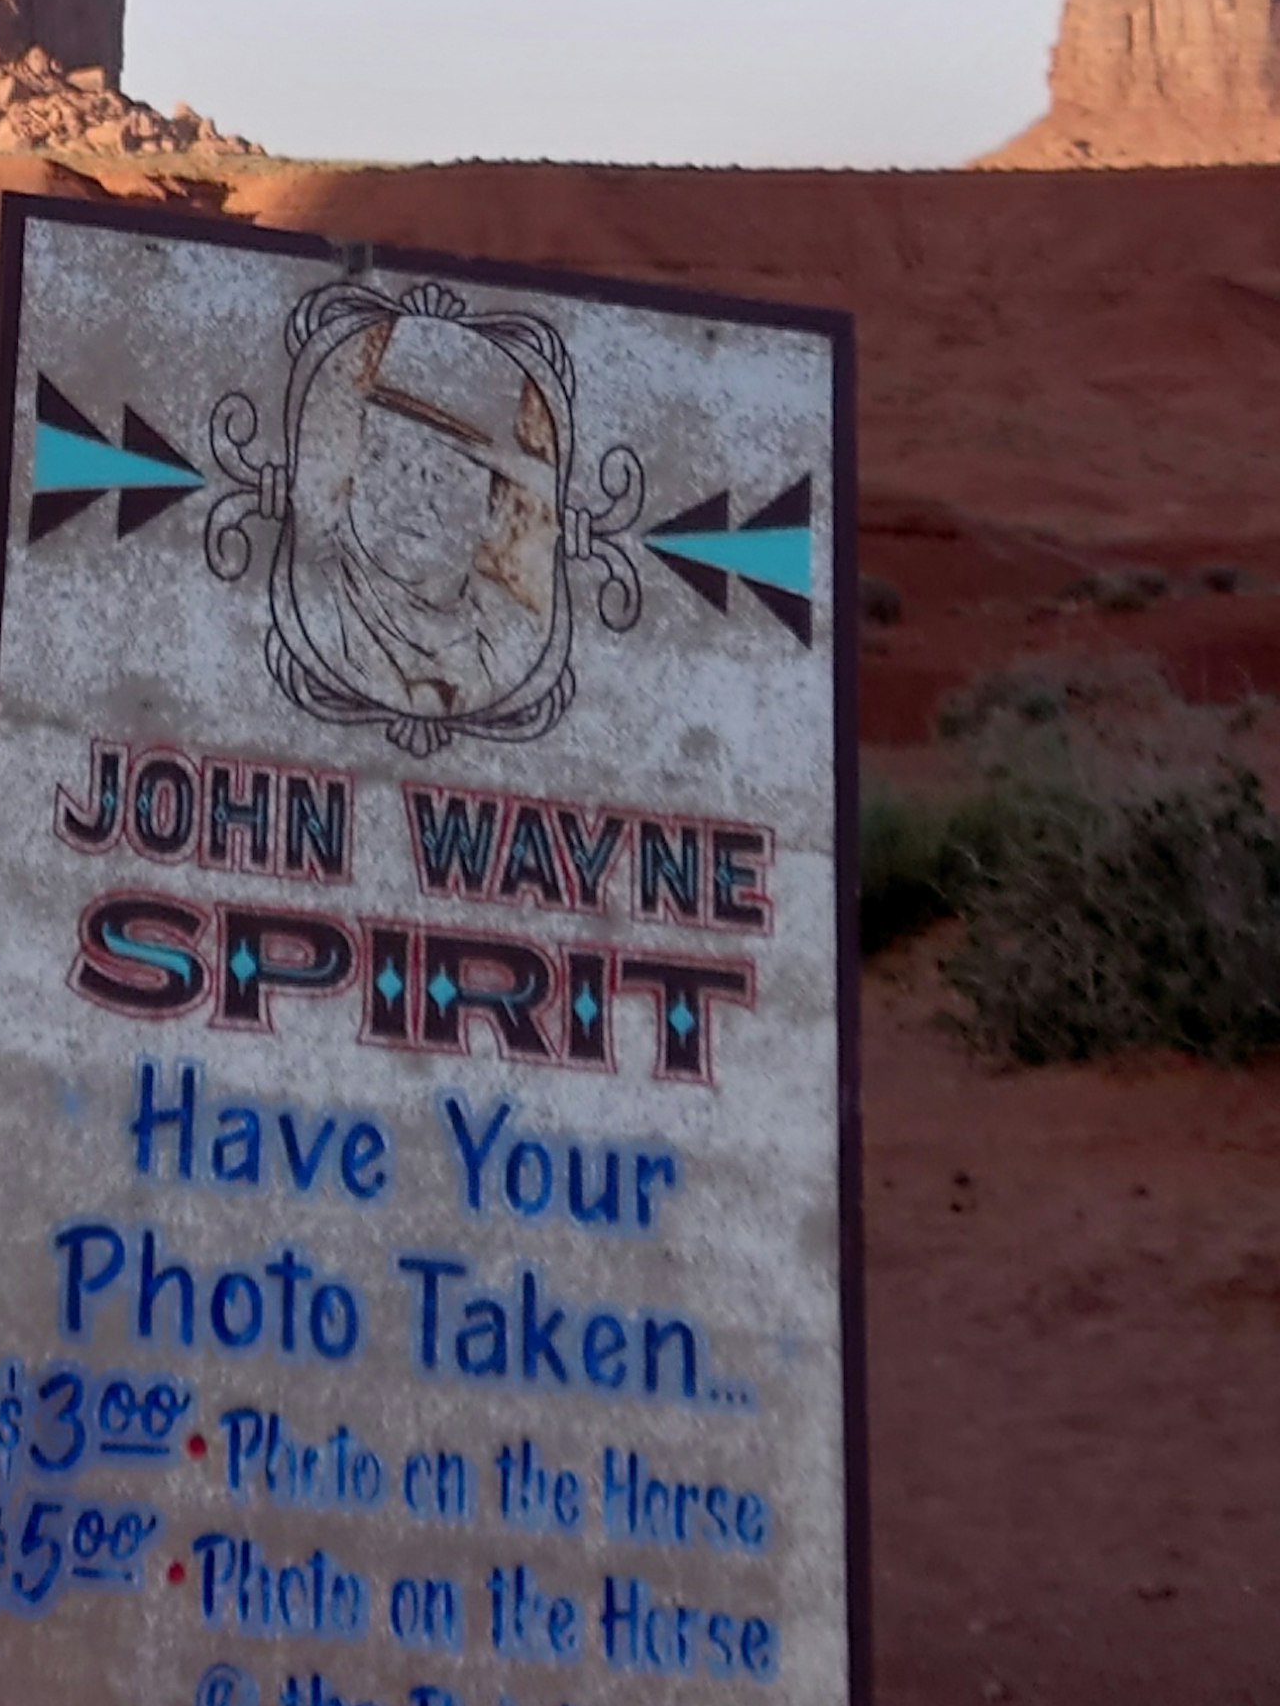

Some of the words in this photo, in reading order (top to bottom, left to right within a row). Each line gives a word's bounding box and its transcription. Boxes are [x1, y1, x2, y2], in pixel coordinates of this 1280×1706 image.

[54, 738, 355, 886] JOHN
[401, 780, 774, 935] WAYNE
[65, 888, 757, 1086] SPIRIT
[130, 1058, 390, 1203] Have
[444, 1094, 679, 1229] Your
[52, 1220, 361, 1362] Photo
[219, 1404, 384, 1504] Photo
[402, 1448, 470, 1518] on
[492, 1436, 582, 1530] the
[600, 1444, 765, 1550] Horse
[190, 1530, 365, 1632] Photo
[388, 1574, 458, 1644] on
[486, 1562, 578, 1654] the
[598, 1572, 773, 1673] Horse
